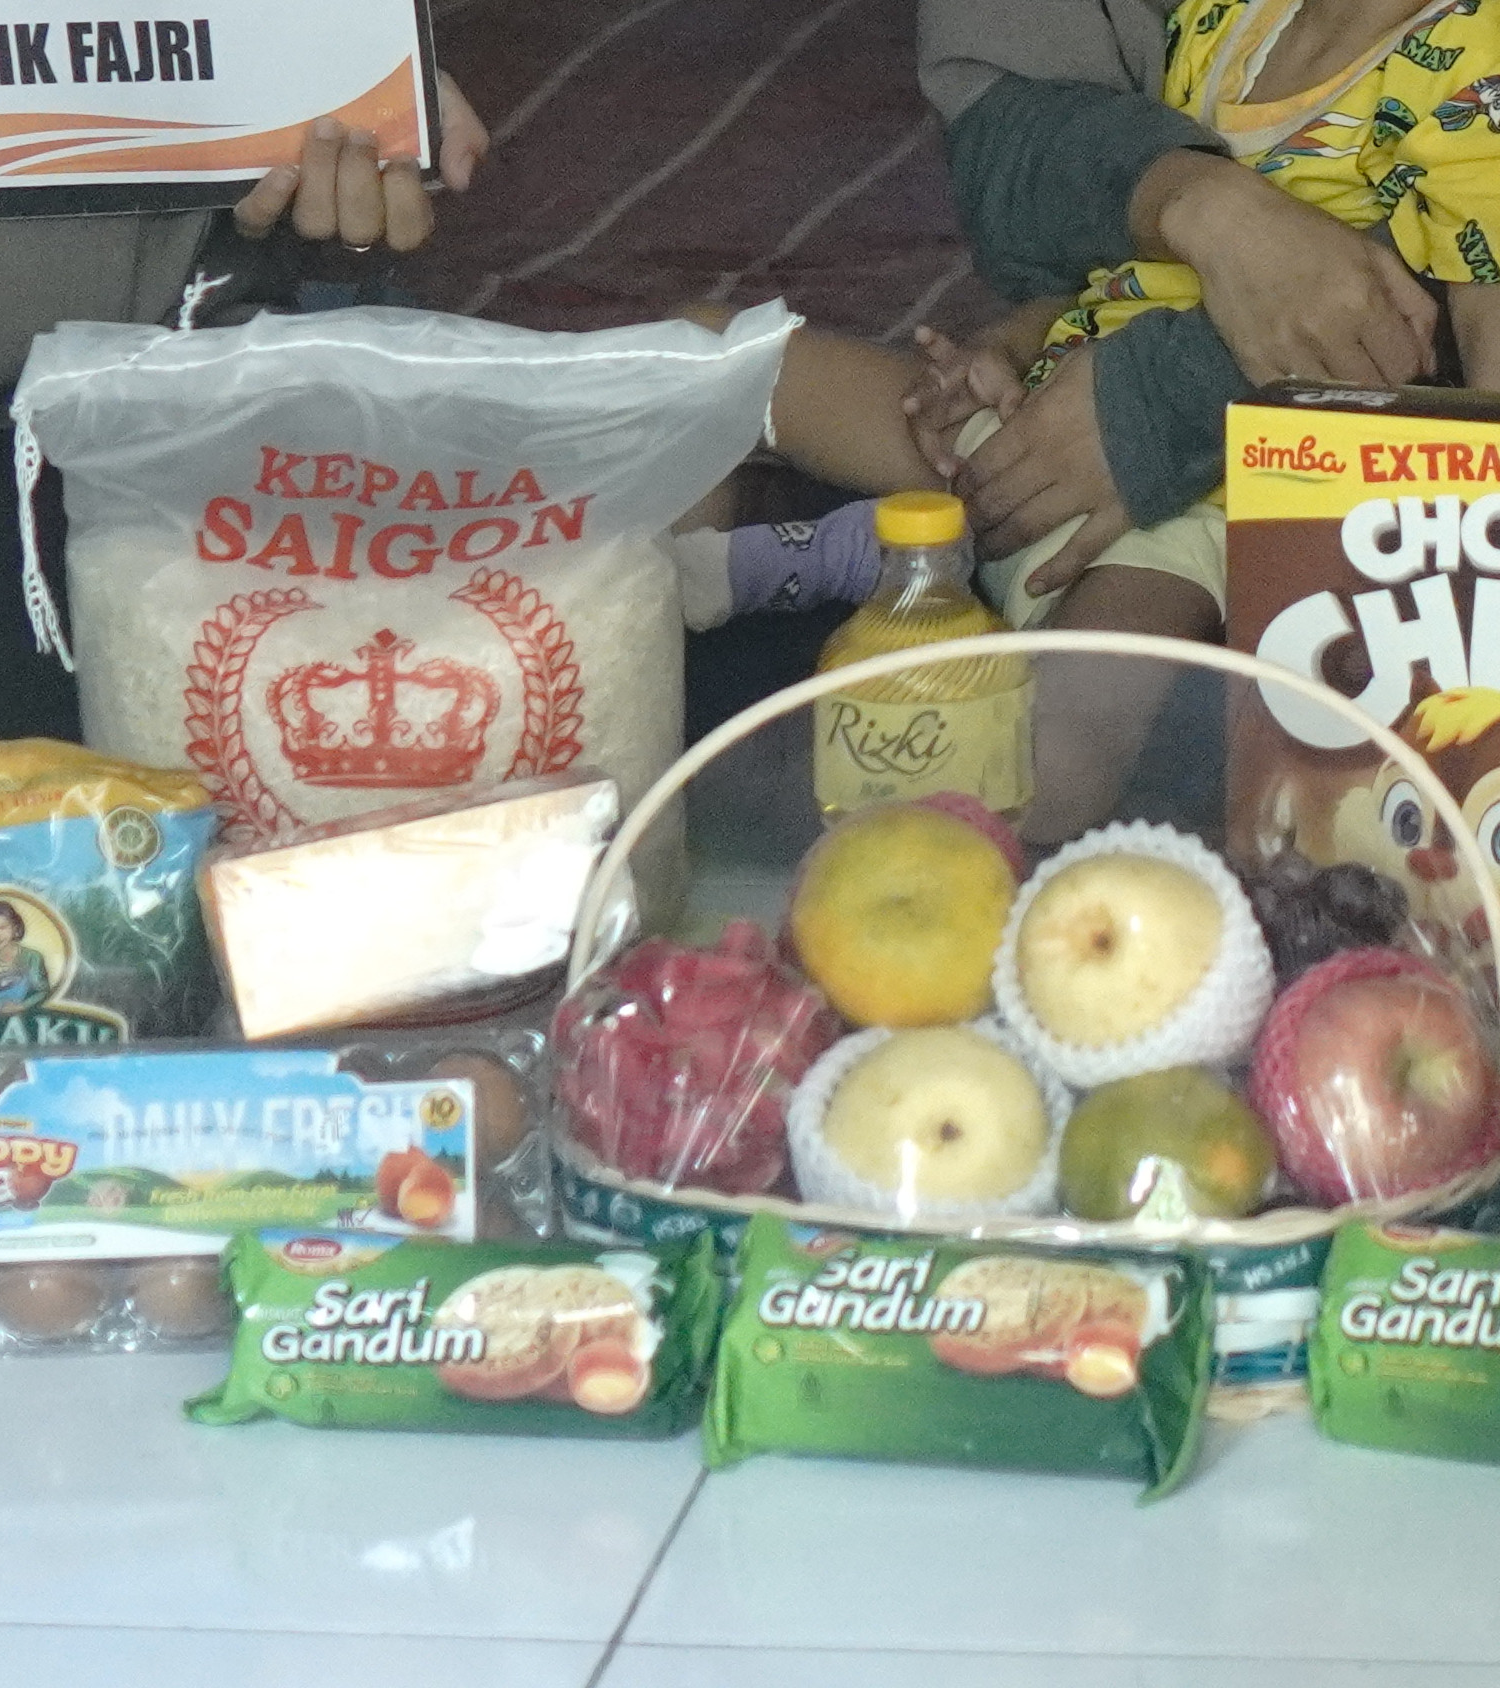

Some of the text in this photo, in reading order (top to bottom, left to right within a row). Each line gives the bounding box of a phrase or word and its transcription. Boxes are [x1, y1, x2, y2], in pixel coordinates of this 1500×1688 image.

[66, 19, 215, 83] FAJRI
[254, 444, 549, 512] KEPALA
[1242, 435, 1347, 475] simba
[196, 494, 597, 580] SAIGON
[827, 702, 953, 775] Rizki
[304, 1276, 430, 1327] Sari
[758, 1277, 986, 1333] Gandum
[261, 1308, 485, 1364] Gandum
